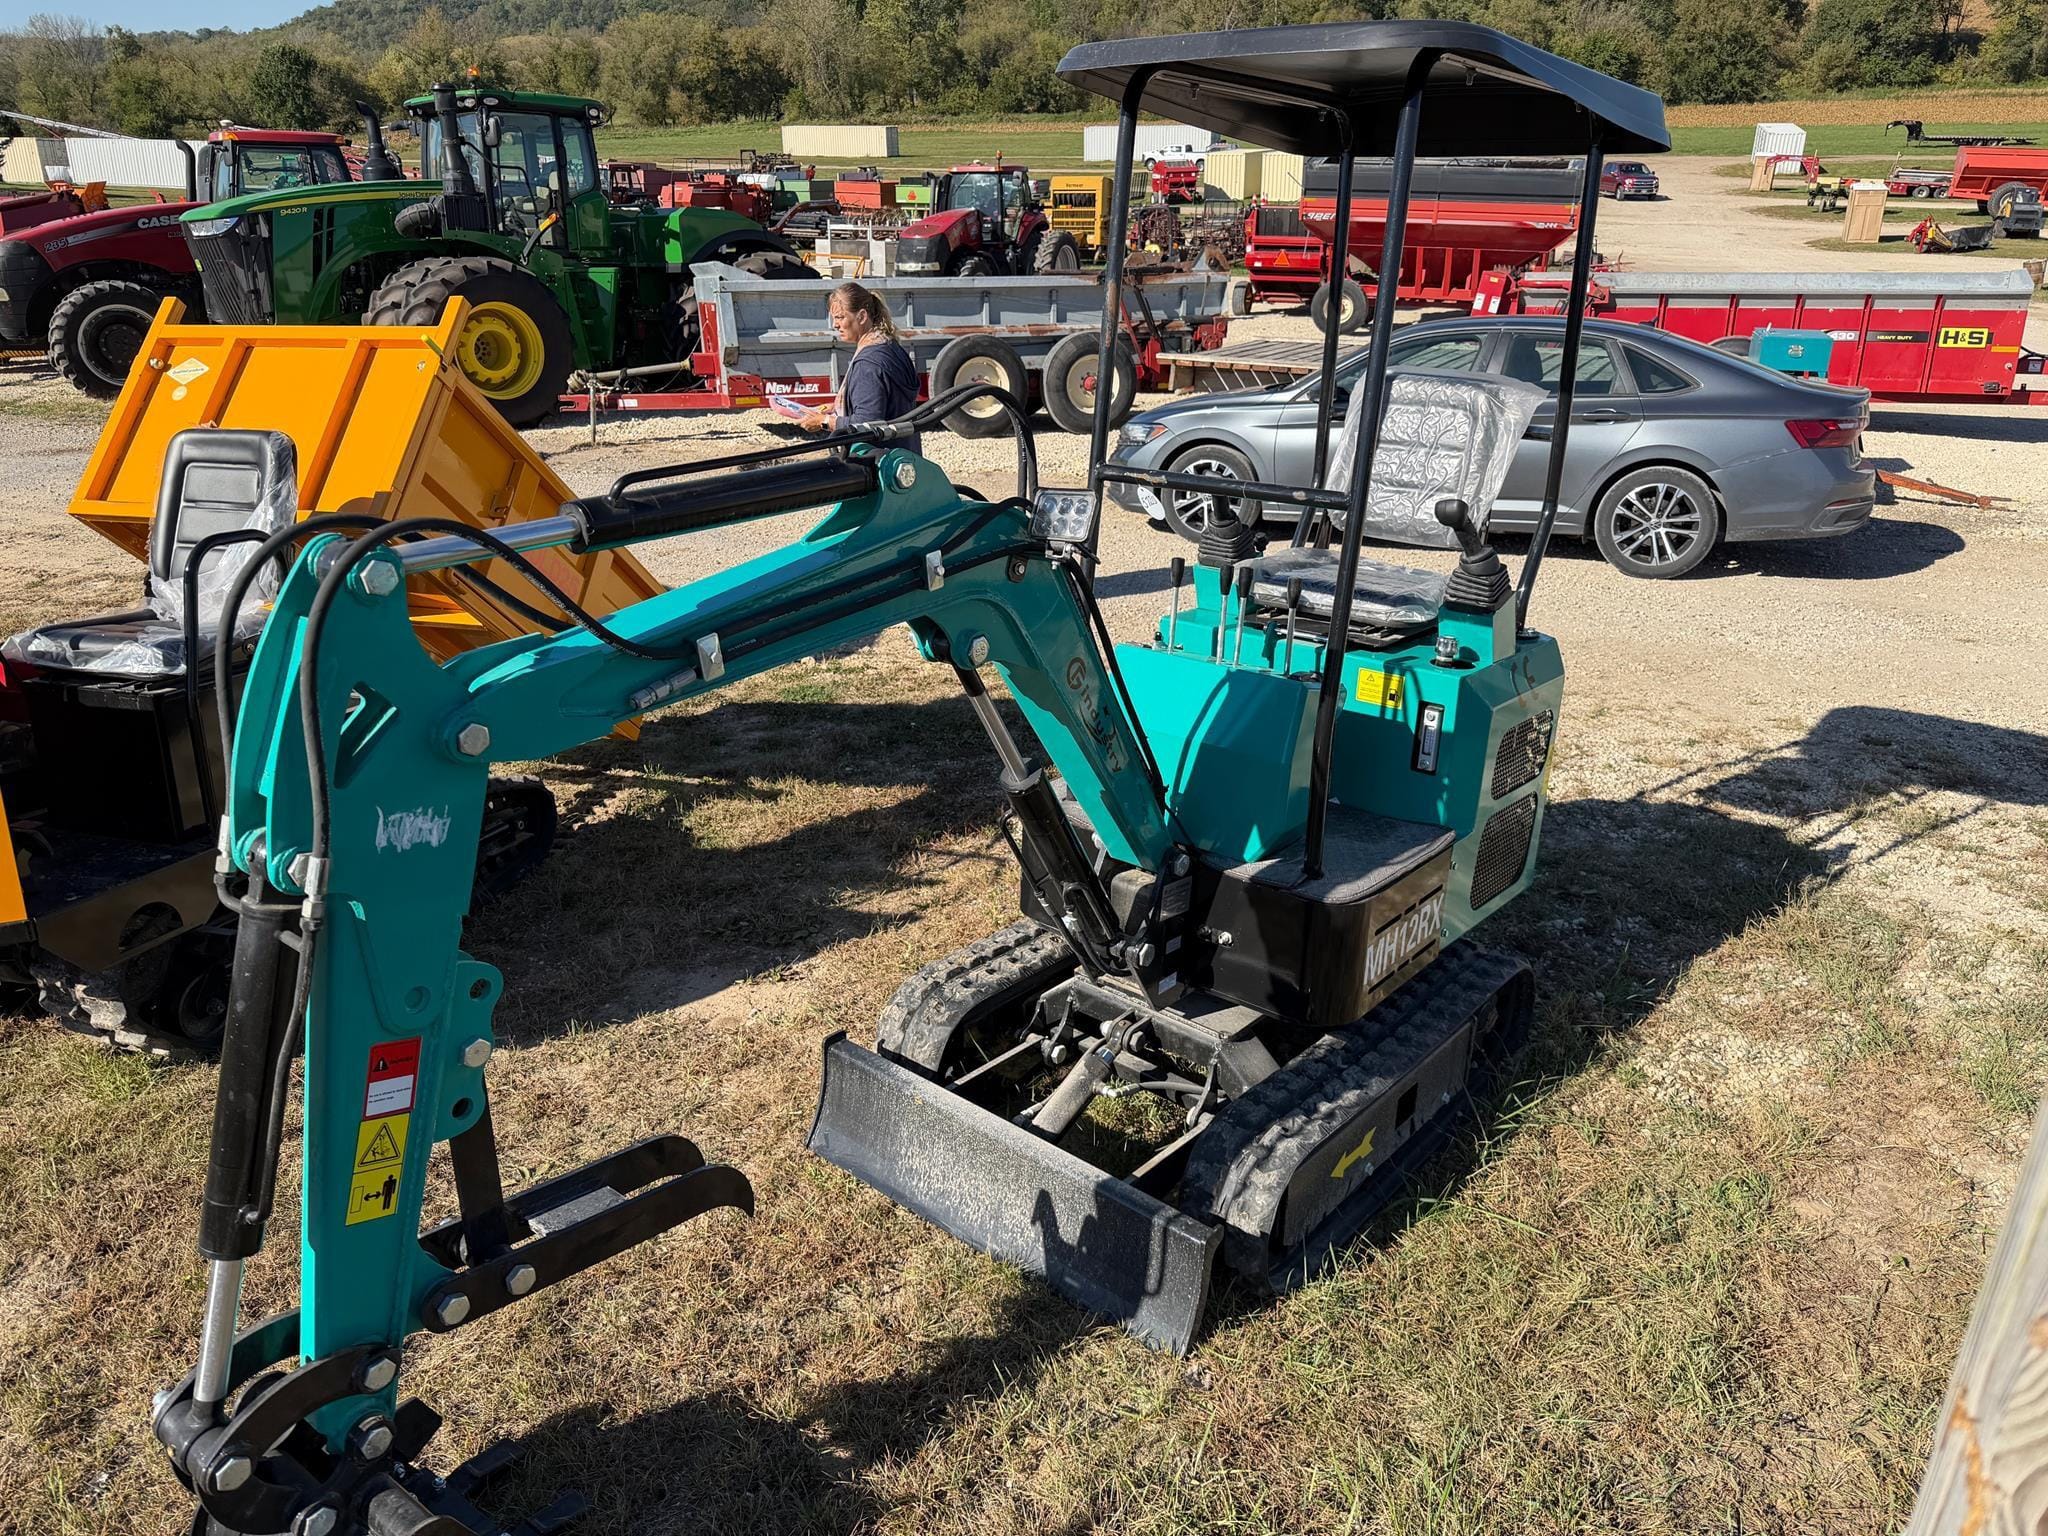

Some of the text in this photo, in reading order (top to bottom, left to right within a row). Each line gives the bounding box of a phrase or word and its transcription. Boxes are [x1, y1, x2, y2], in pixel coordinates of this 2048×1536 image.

[137, 214, 181, 229] CASE
[44, 237, 67, 253] 235
[1942, 330, 1985, 345] H&S
[1363, 892, 1444, 985] MH12RX
